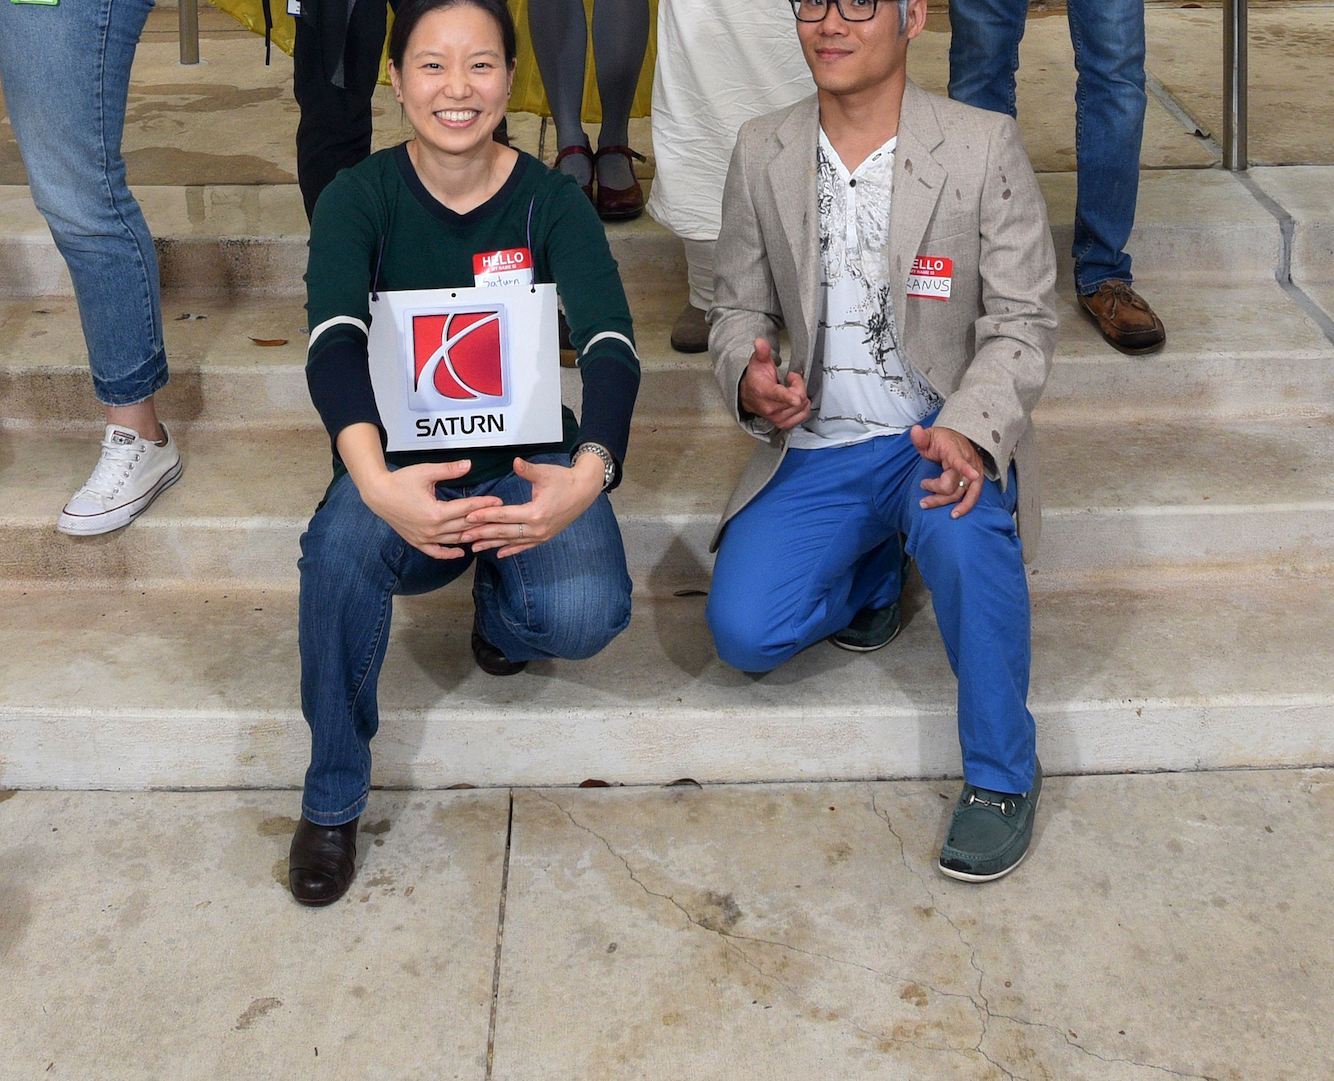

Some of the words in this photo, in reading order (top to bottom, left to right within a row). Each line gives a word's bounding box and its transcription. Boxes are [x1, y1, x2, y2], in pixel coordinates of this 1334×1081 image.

[482, 251, 524, 267] HELLO
[913, 259, 944, 271] ELLO
[483, 275, 520, 288] Saturn
[907, 277, 950, 292] RANUS
[415, 413, 504, 437] SATURN
